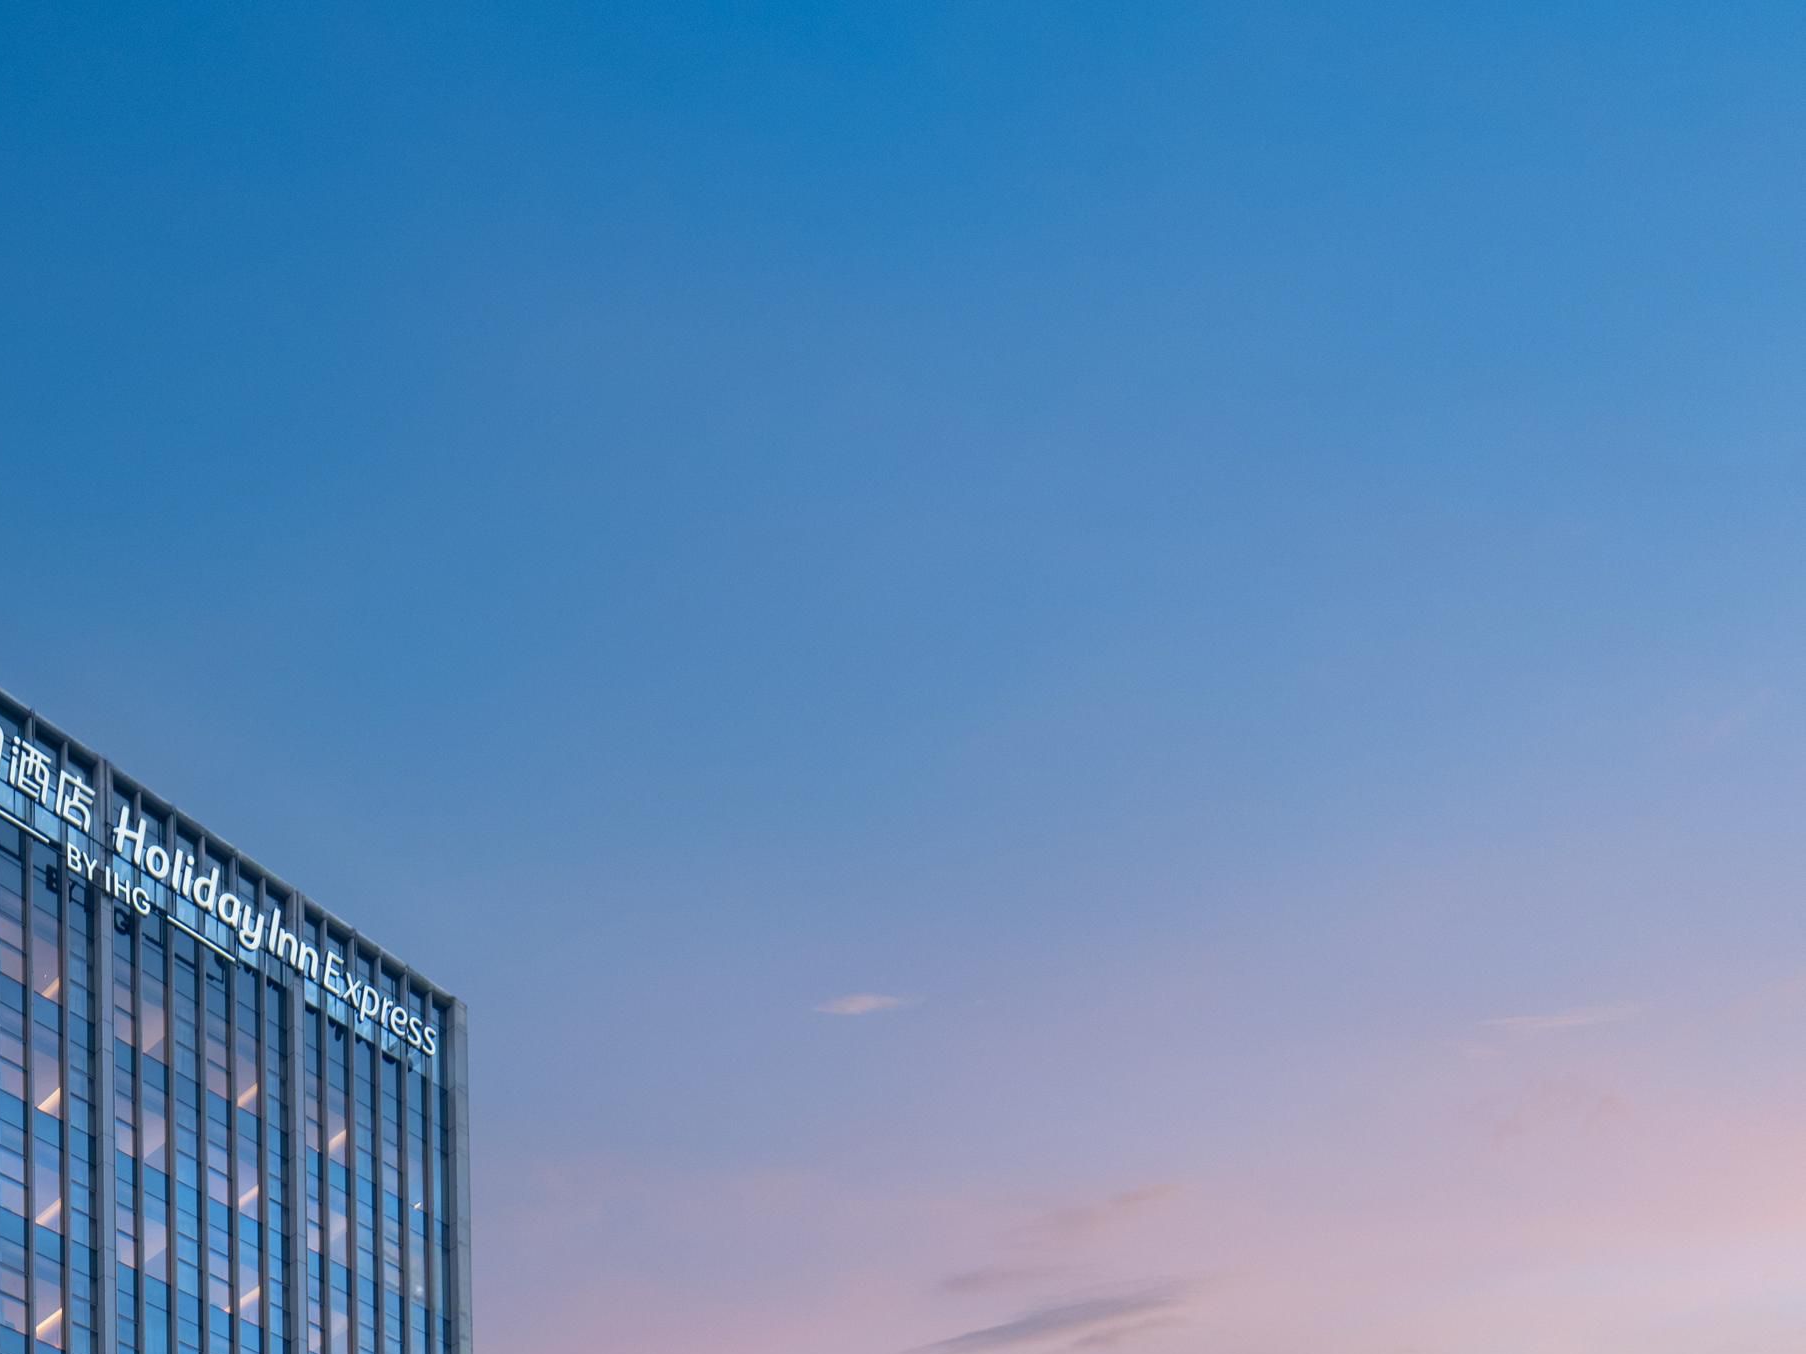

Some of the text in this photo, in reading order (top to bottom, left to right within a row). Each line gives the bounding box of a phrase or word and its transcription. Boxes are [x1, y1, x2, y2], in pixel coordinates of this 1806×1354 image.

[67, 841, 151, 916] BY IHG
[113, 805, 264, 951] Holiday
[267, 907, 320, 980] Inn
[323, 950, 438, 1057] Express
